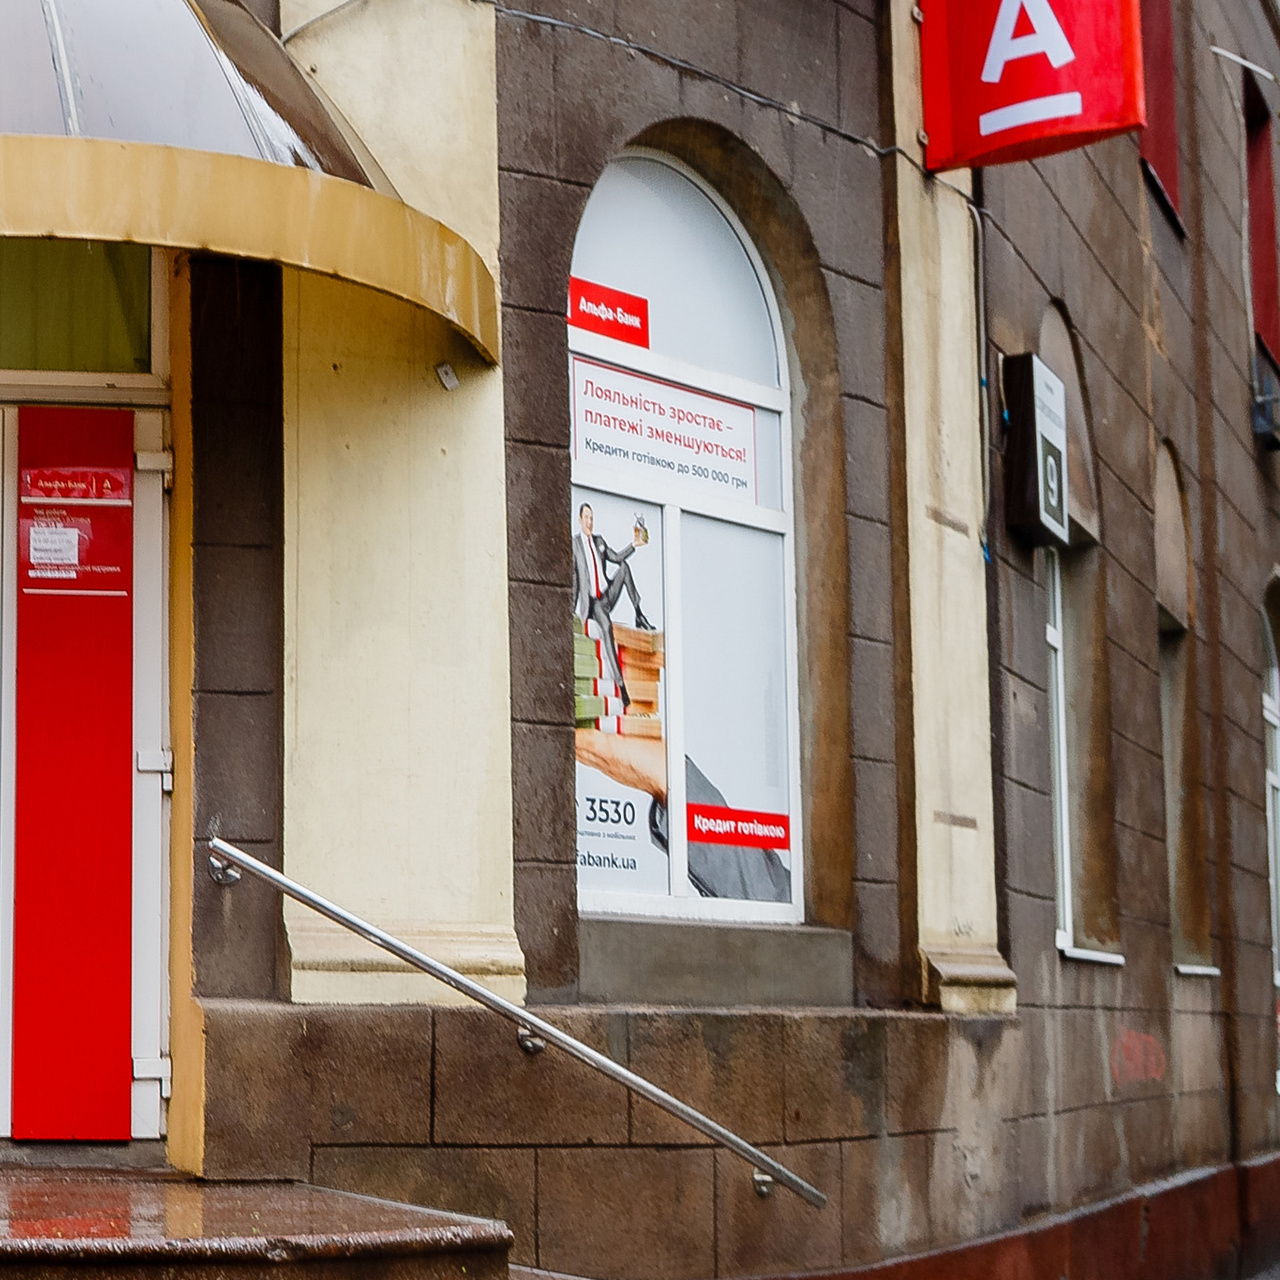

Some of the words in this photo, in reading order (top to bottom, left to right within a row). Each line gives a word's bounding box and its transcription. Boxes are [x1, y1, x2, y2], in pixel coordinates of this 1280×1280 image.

[583, 379, 666, 417] Лояльність
[669, 405, 724, 433] зростає
[584, 409, 643, 437] платежі
[647, 426, 747, 463] зменшуються!
[585, 437, 630, 461] Кредити
[632, 451, 675, 471] готівкою
[677, 464, 690, 475] до
[692, 464, 710, 479] 500
[712, 469, 730, 484] 000
[731, 477, 748, 489] грн
[1046, 454, 1059, 508] 9
[585, 796, 636, 826] 3530
[694, 814, 736, 835] Кредит
[737, 819, 786, 839] готівкою
[577, 849, 637, 870] abank.ua
